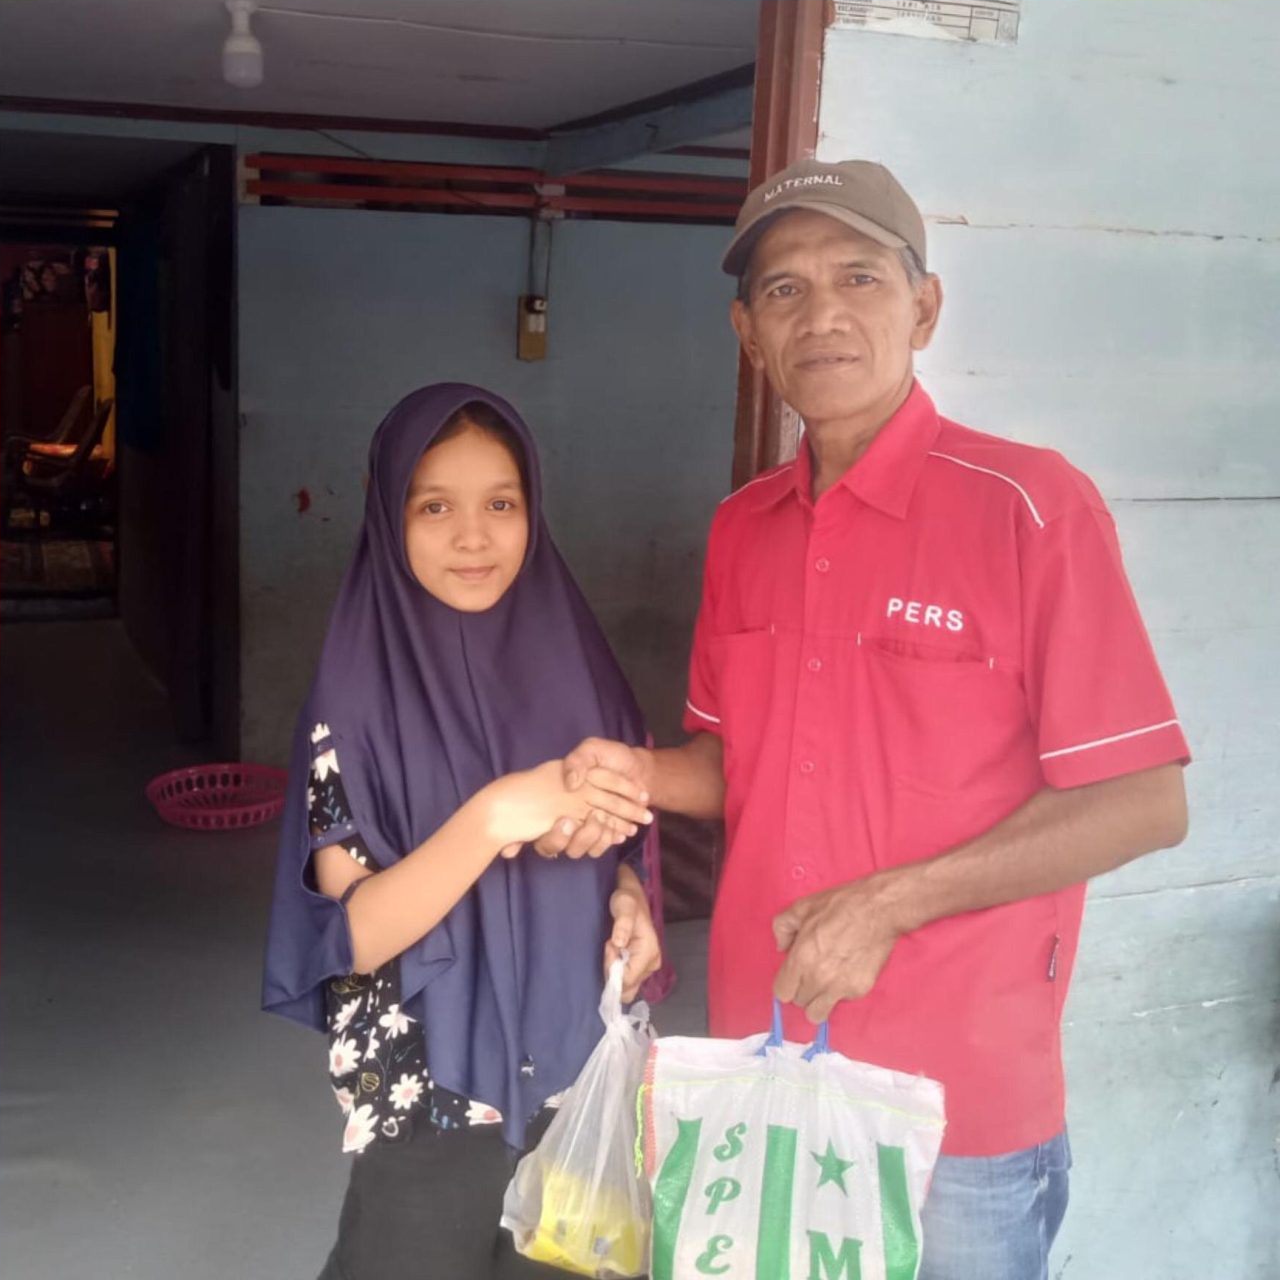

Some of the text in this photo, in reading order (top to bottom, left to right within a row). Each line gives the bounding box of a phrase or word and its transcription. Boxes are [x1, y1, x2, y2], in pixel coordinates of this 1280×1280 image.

[763, 175, 843, 203] MATERNAL
[886, 597, 964, 631] PERS
[695, 1122, 747, 1275] SPE
[806, 1229, 863, 1280] M
